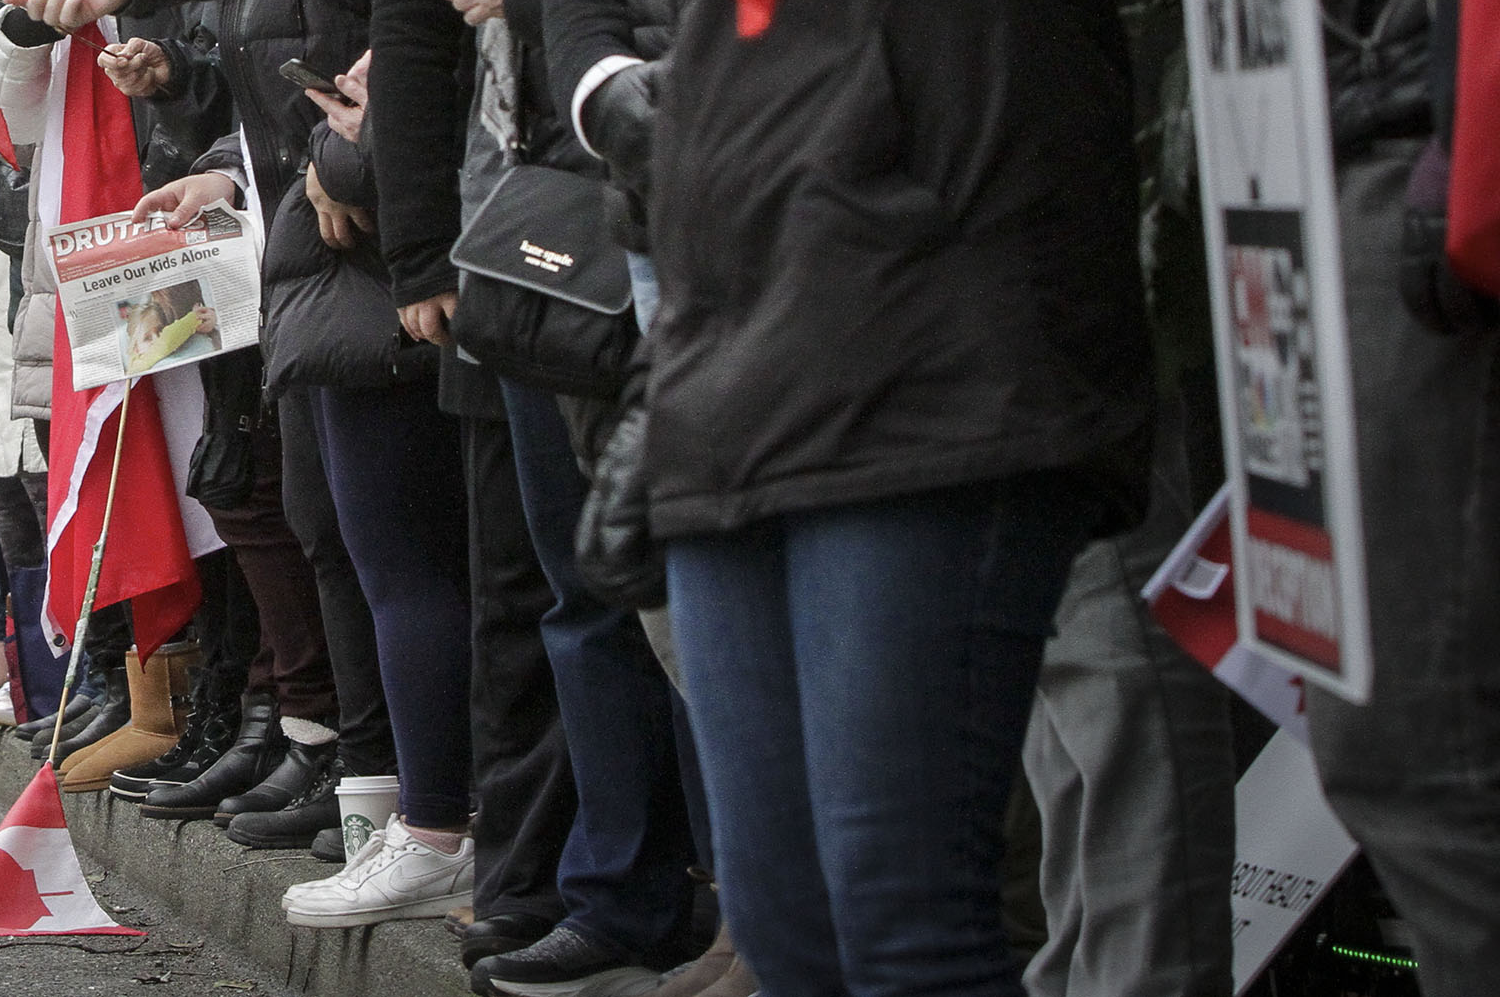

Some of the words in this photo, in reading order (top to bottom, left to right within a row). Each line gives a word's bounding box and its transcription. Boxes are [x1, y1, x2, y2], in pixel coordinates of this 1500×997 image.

[83, 272, 121, 293] Leave
[123, 266, 146, 280] Our
[149, 256, 177, 275] Kids
[181, 246, 220, 265] Alone
[1231, 861, 1275, 900] BOUT
